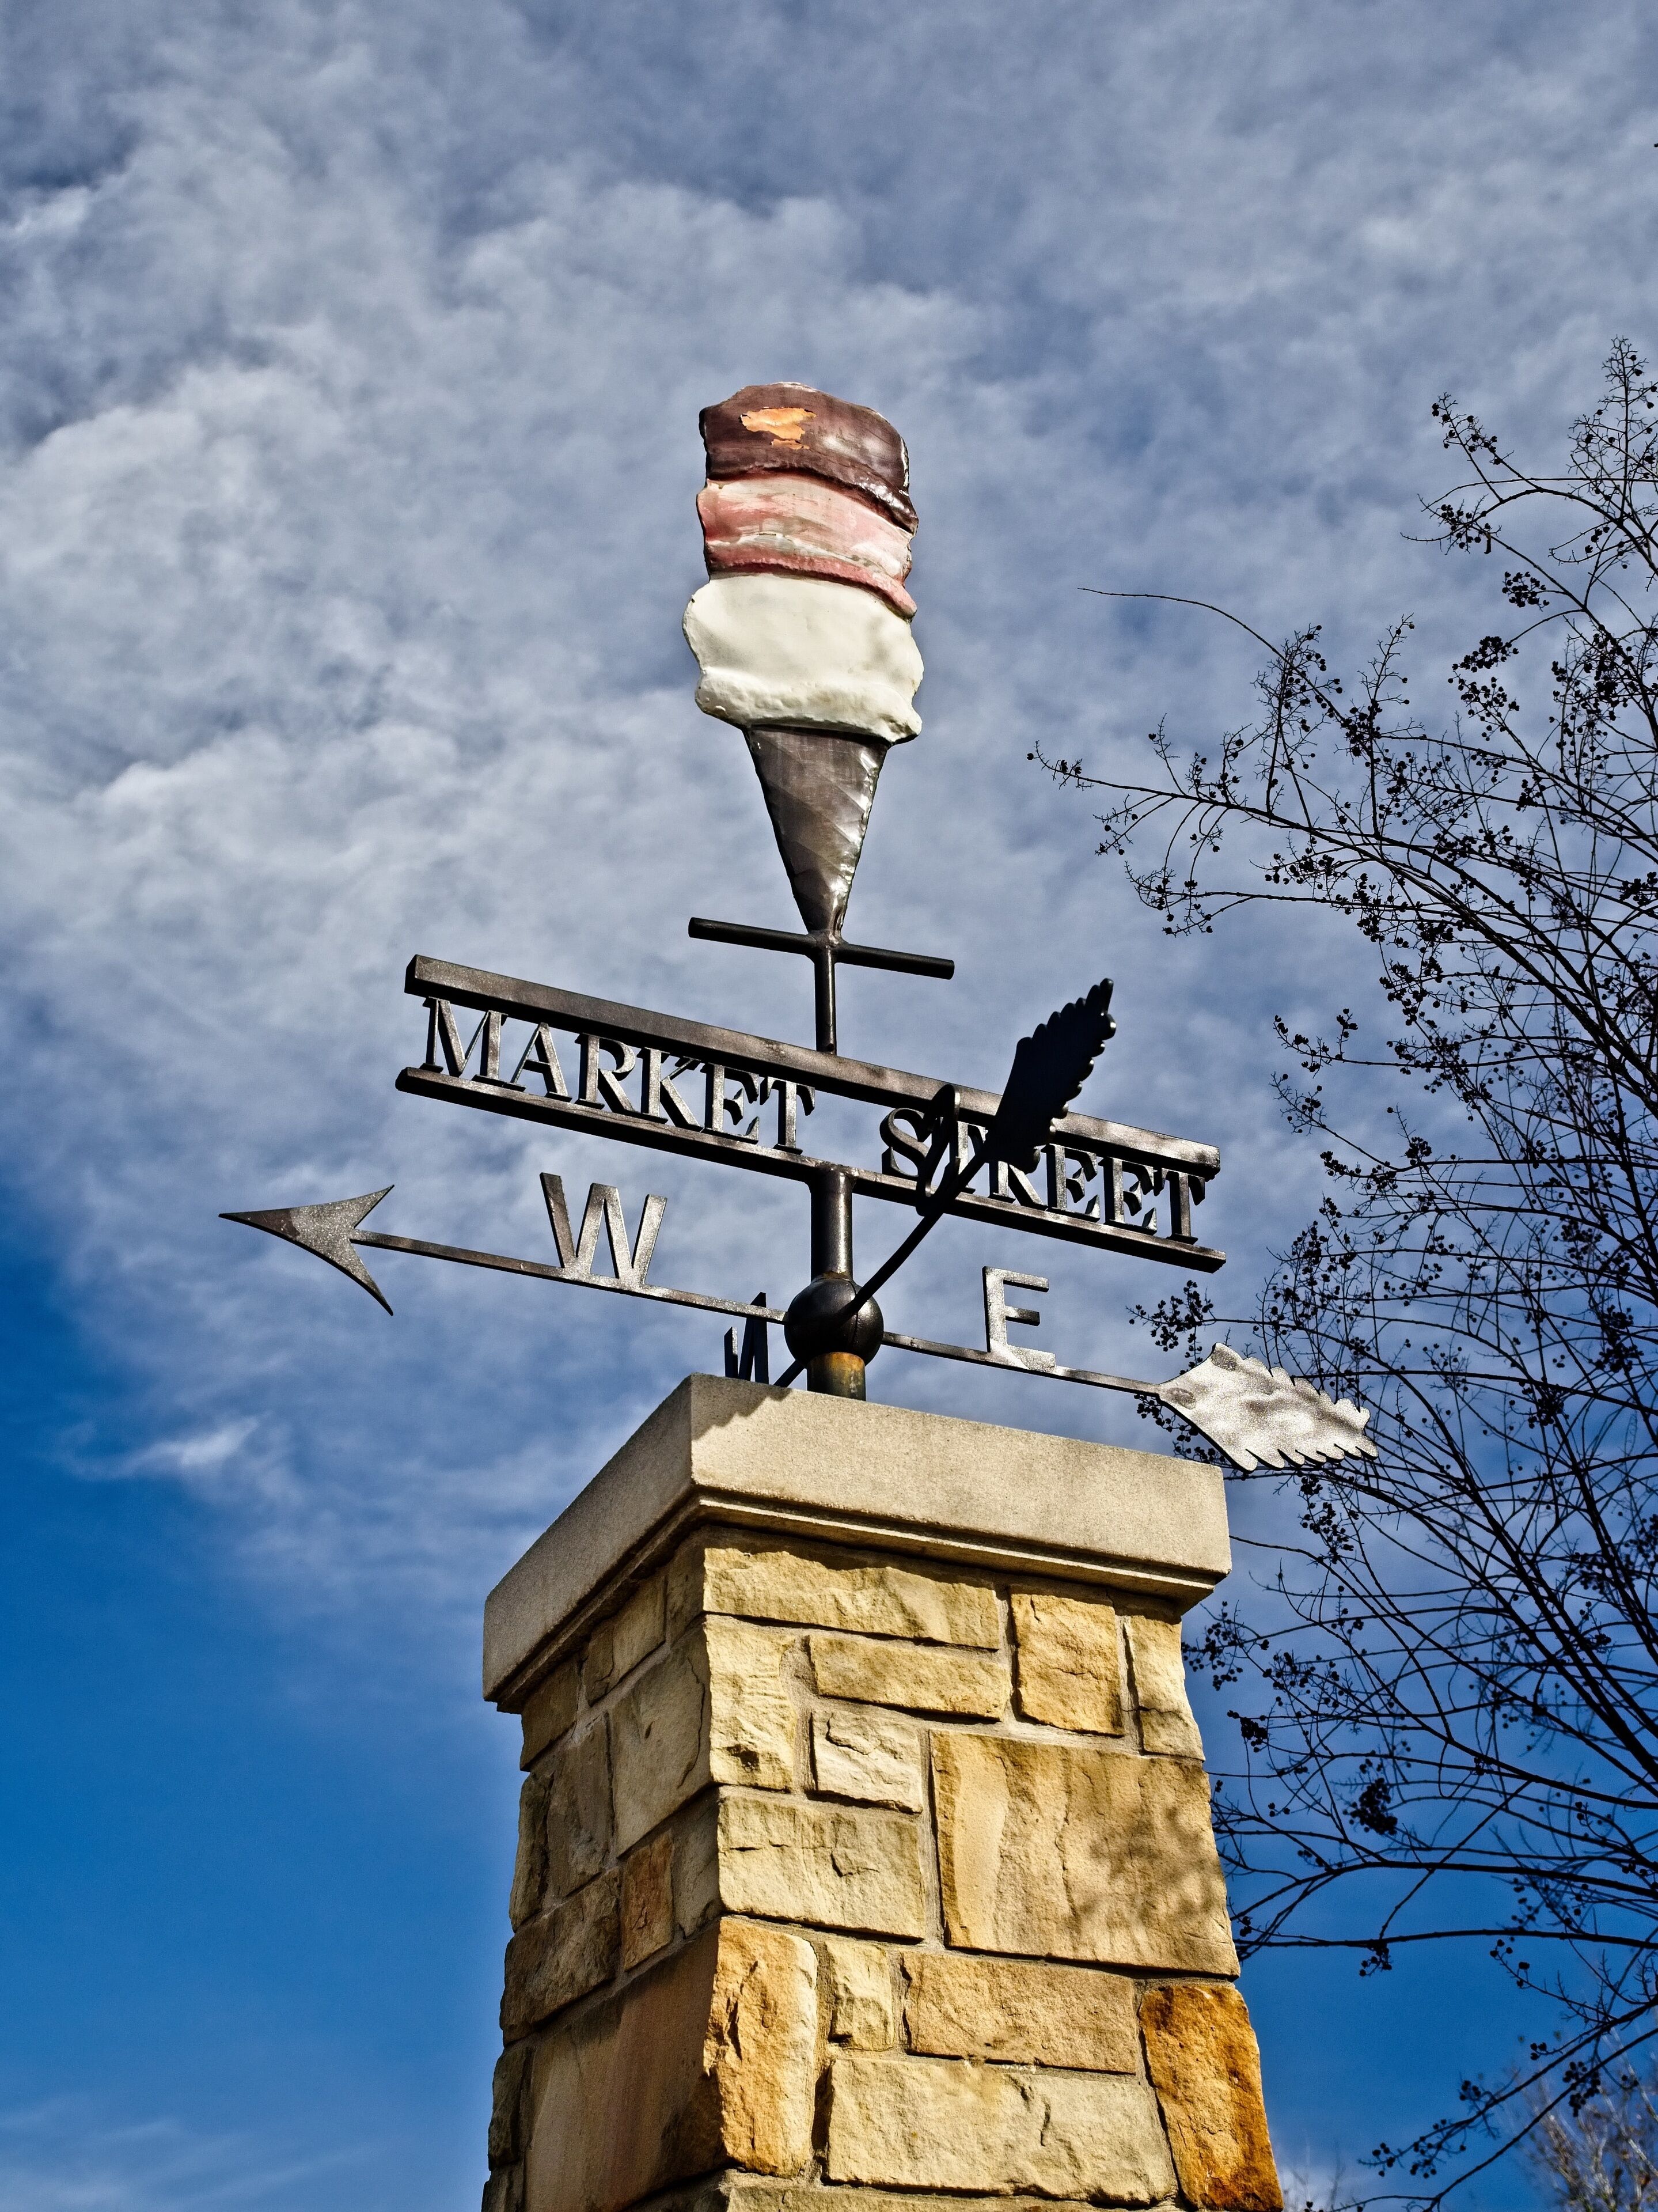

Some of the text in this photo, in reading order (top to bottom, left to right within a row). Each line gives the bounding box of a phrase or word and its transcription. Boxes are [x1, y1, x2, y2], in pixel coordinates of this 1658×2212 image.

[419, 997, 815, 1154] MARKET
[539, 1172, 667, 1293] W
[982, 1266, 1056, 1372] E
